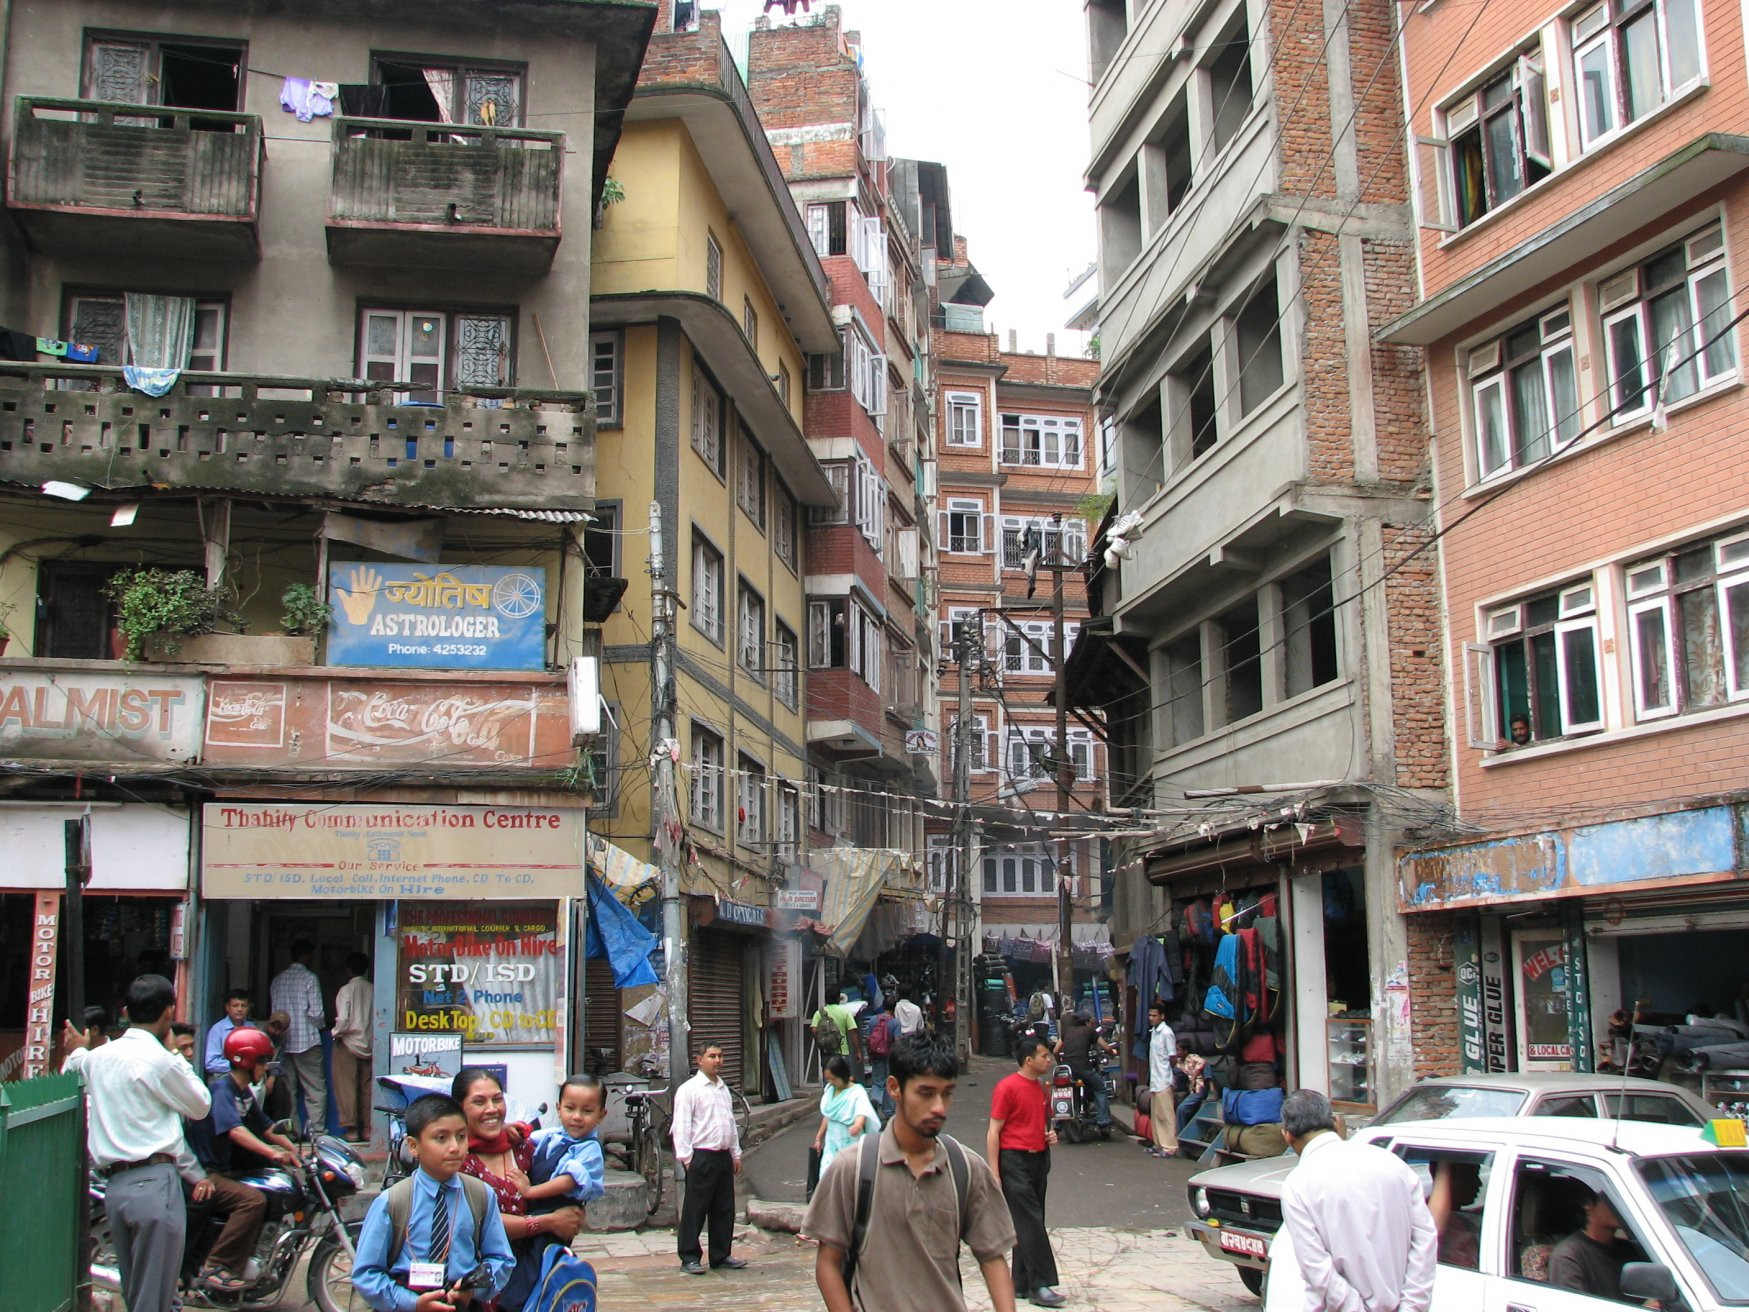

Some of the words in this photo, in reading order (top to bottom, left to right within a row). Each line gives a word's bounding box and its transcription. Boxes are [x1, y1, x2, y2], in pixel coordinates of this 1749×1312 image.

[385, 572, 493, 610] ज्योतिष
[370, 613, 501, 638] ASTROLOGER
[388, 643, 430, 656] Phone:
[433, 644, 487, 656] 4253232
[483, 810, 561, 829] Centre
[339, 861, 362, 870] Our
[370, 861, 419, 871] Service
[310, 874, 343, 883] Local
[473, 875, 488, 883] CD
[496, 874, 512, 883] To
[515, 874, 535, 885] CD,
[311, 885, 374, 894] Motorbike
[379, 885, 394, 894] On
[400, 885, 445, 894] Hire
[34, 914, 56, 980] MOTOR
[496, 936, 517, 956] On
[521, 934, 557, 957] Hire
[31, 983, 54, 1002] BIKE
[424, 989, 453, 1004] Net
[473, 989, 523, 1004] Phone
[1485, 975, 1504, 1025] GLUE
[489, 1010, 515, 1030] CD
[1463, 994, 1481, 1061] GLUE
[392, 1036, 462, 1057] MOTORBIKE
[1537, 1045, 1560, 1056] LOCAL
